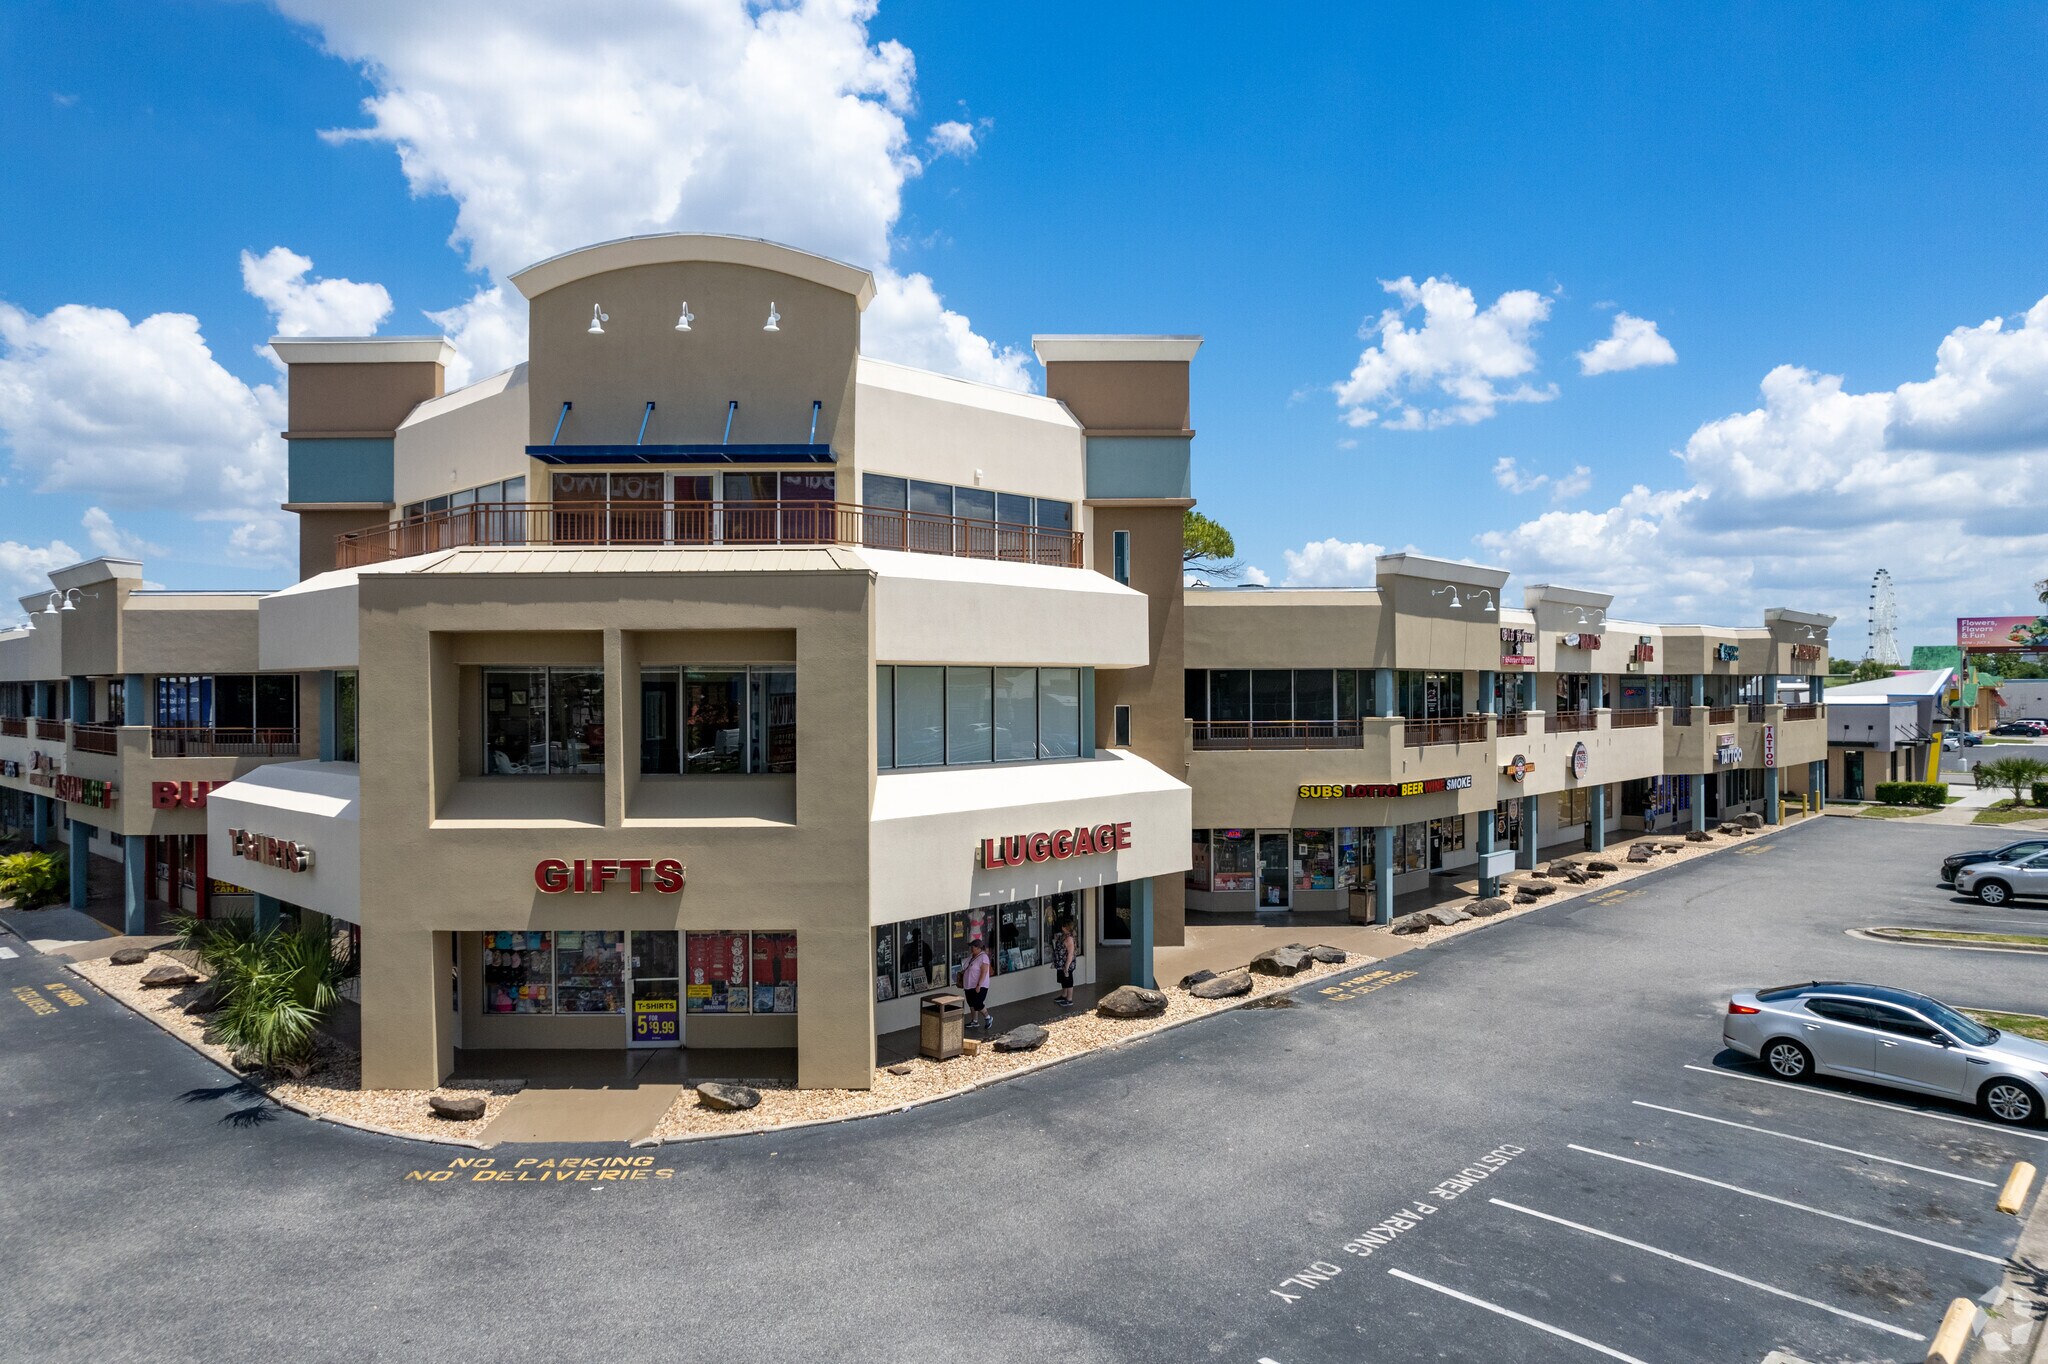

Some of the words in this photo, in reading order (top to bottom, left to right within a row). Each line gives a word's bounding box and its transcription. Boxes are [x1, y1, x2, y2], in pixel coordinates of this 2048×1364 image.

[1961, 619, 1998, 627] Flowers,
[1720, 748, 1743, 765] TATTOO
[1766, 726, 1774, 766] TATTOO
[152, 780, 231, 809] BU
[1299, 785, 1343, 799] SUBS
[1345, 785, 1398, 798] LOTTO
[1401, 781, 1424, 797] BEER
[1424, 778, 1446, 794] WINE
[1446, 775, 1472, 791] SMOKE
[981, 821, 1133, 870] LUGGAGE
[533, 858, 686, 895] GIFTS
[637, 1002, 675, 1010] T-SHIRTS
[637, 1014, 648, 1034] 5
[404, 1169, 455, 1182] NO
[471, 1168, 676, 1182] DELIVERIES
[447, 1157, 496, 1169] NO
[514, 1155, 655, 1169] PARKING
[1428, 1143, 1526, 1201] CUSTOMER
[1342, 1200, 1438, 1257] PARKING
[1269, 1260, 1342, 1304] ONLY
